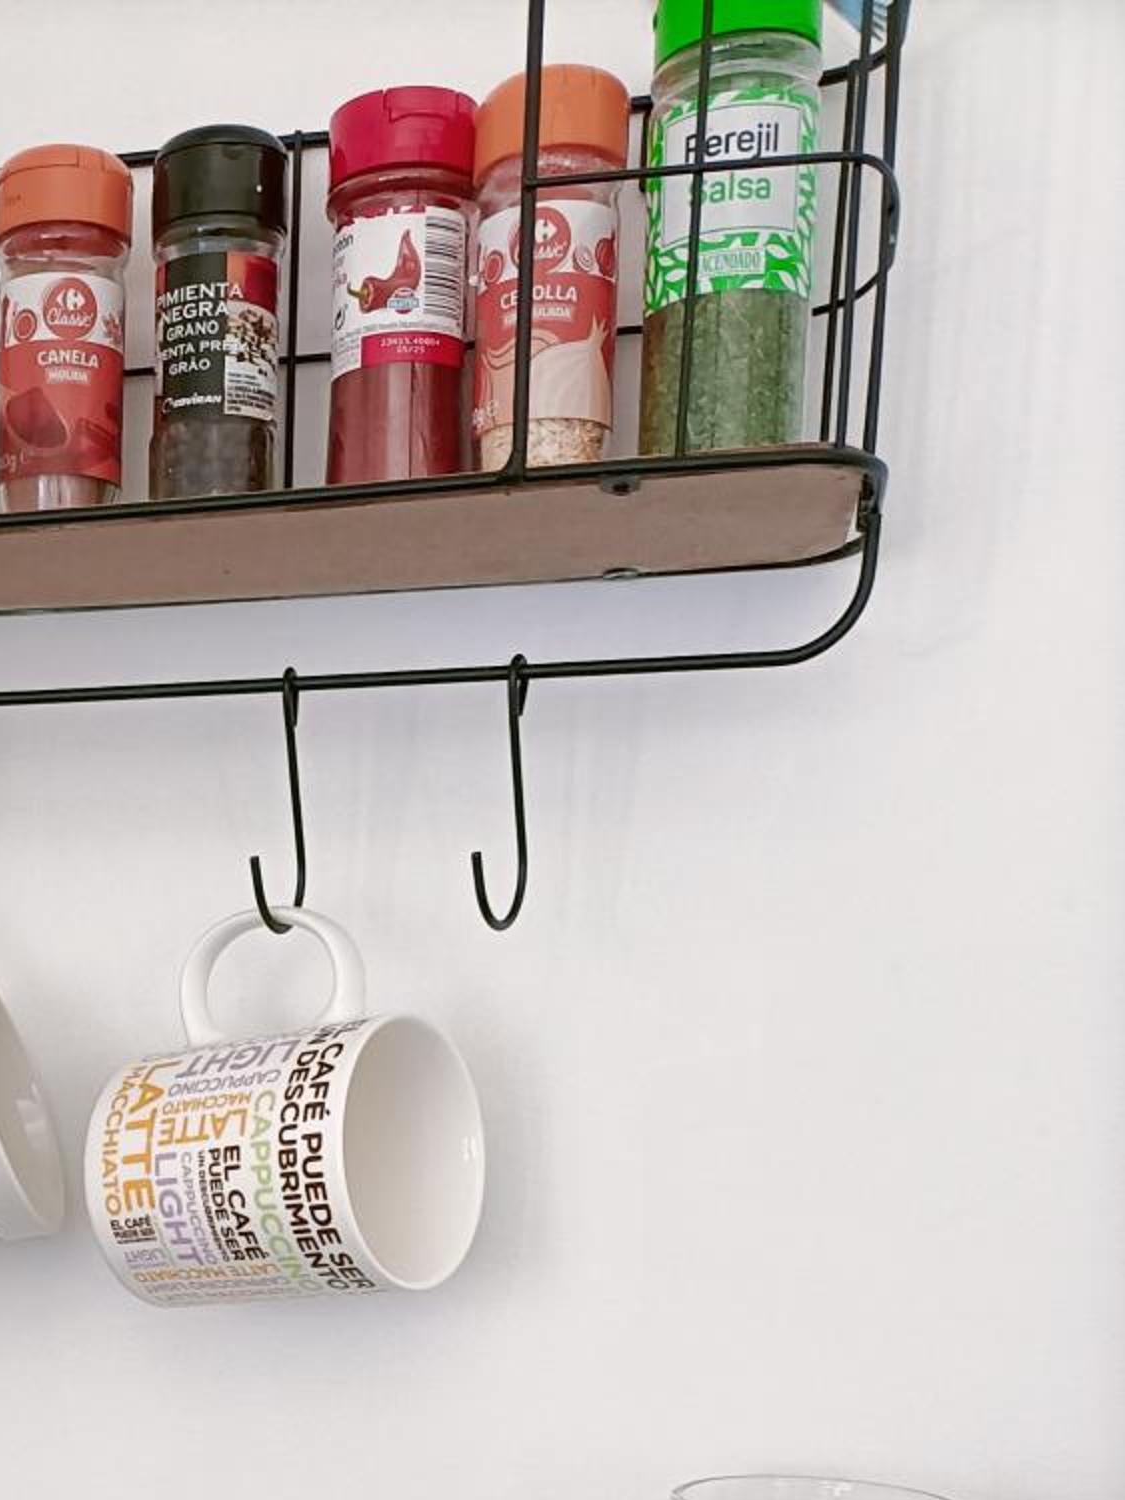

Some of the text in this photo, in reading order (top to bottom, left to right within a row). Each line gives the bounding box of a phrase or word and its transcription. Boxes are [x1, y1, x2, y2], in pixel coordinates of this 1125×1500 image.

[684, 122, 780, 163] Perejil
[699, 251, 763, 274] ACENDADO
[161, 300, 230, 325] NEGRA
[499, 285, 578, 310] CEOLLA
[166, 319, 220, 341] GRANO
[36, 349, 100, 369] CANELA
[176, 1038, 302, 1078] LIGHT
[162, 1090, 253, 1115] MACCHIATO
[167, 1068, 281, 1097] CAPPUCCINO
[302, 1042, 344, 1123] CAFÉ
[122, 1059, 181, 1213] LATTE
[157, 1106, 248, 1147] LATTE
[277, 1048, 350, 1291] DESCUBRIMIENTO
[301, 1131, 343, 1246] PUEDE
[154, 1152, 204, 1266] LIGHT
[180, 1151, 218, 1265] CAPPUCCINO
[207, 1147, 246, 1261] PUEDE SER
[223, 1144, 271, 1261] EL CAFÉ
[250, 1090, 323, 1292] CAPPUCCINO
[328, 1252, 376, 1290] SER
